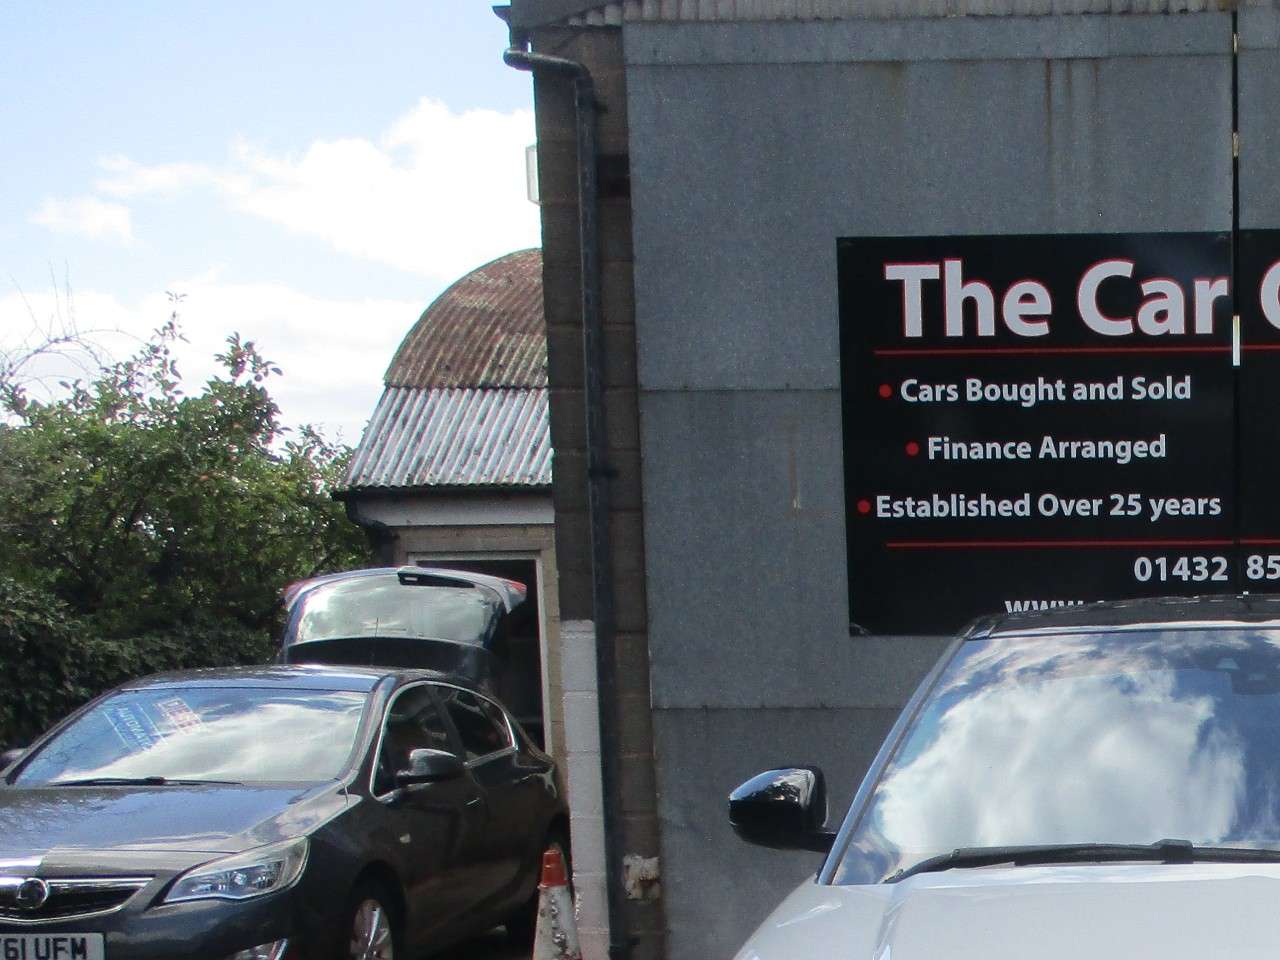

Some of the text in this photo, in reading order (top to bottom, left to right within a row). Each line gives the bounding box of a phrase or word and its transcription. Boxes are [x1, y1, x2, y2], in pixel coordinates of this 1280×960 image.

[884, 258, 1053, 338] The
[1076, 259, 1229, 337] Car
[900, 375, 1191, 408] Cars Bought and Sold
[928, 433, 1166, 465] Finance Arranged
[876, 492, 1222, 522] Established Over 25 years
[1133, 556, 1229, 582] 01432
[0, 937, 87, 960] 61 UFM
